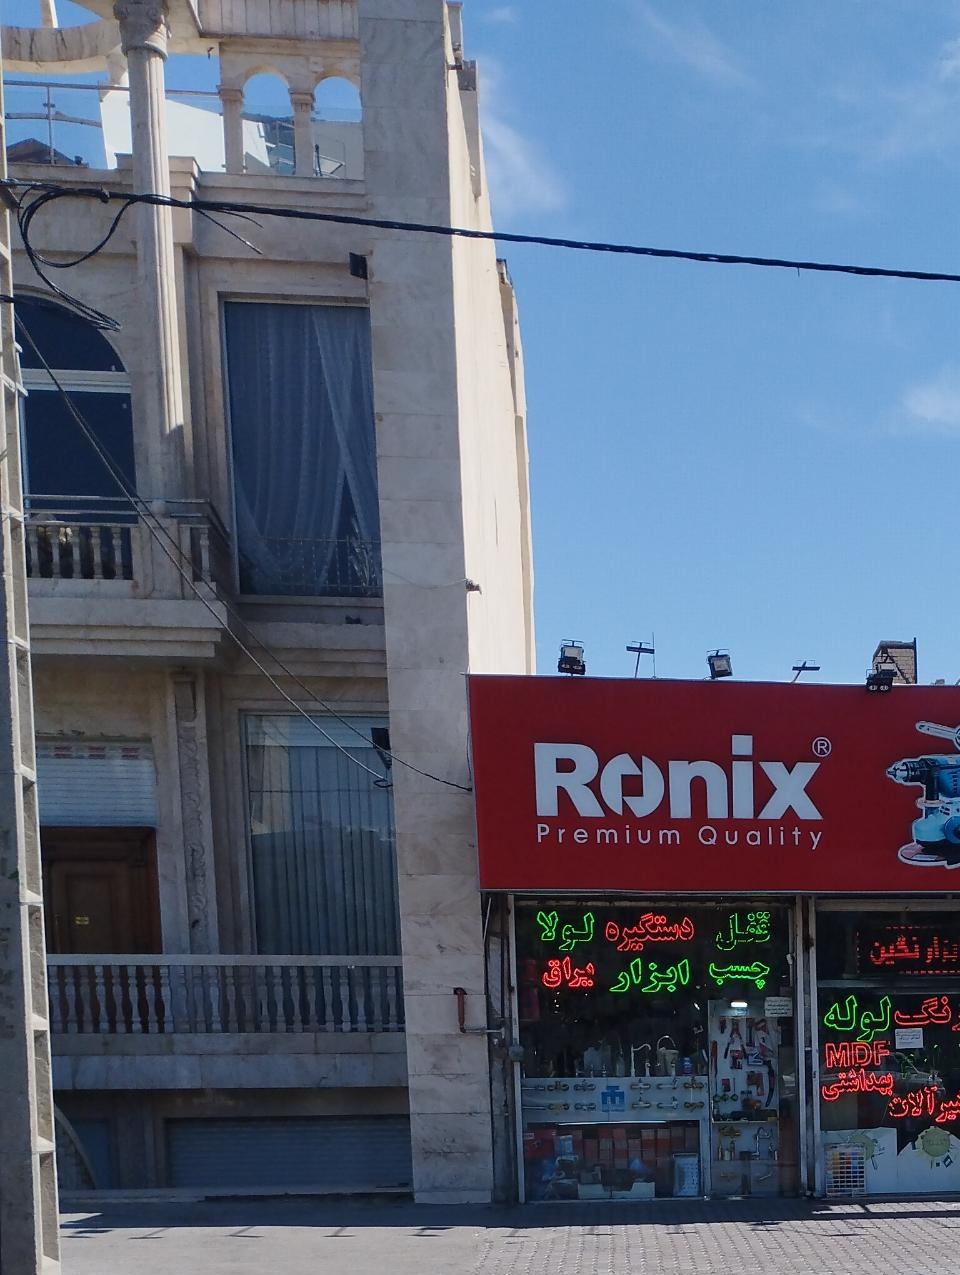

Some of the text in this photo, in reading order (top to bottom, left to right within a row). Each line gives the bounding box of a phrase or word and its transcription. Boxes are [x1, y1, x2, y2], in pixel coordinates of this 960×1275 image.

[533, 734, 825, 821] Ronix
[536, 823, 824, 851] Premium Quality
[536, 910, 596, 951] لولا
[604, 912, 695, 952] دستگیره
[869, 935, 921, 966] نگین
[541, 956, 771, 993] چسب ابزار یراق
[823, 994, 892, 1043] لوله
[825, 1041, 890, 1069] MDF
[822, 1068, 894, 1101] بهداشتی
